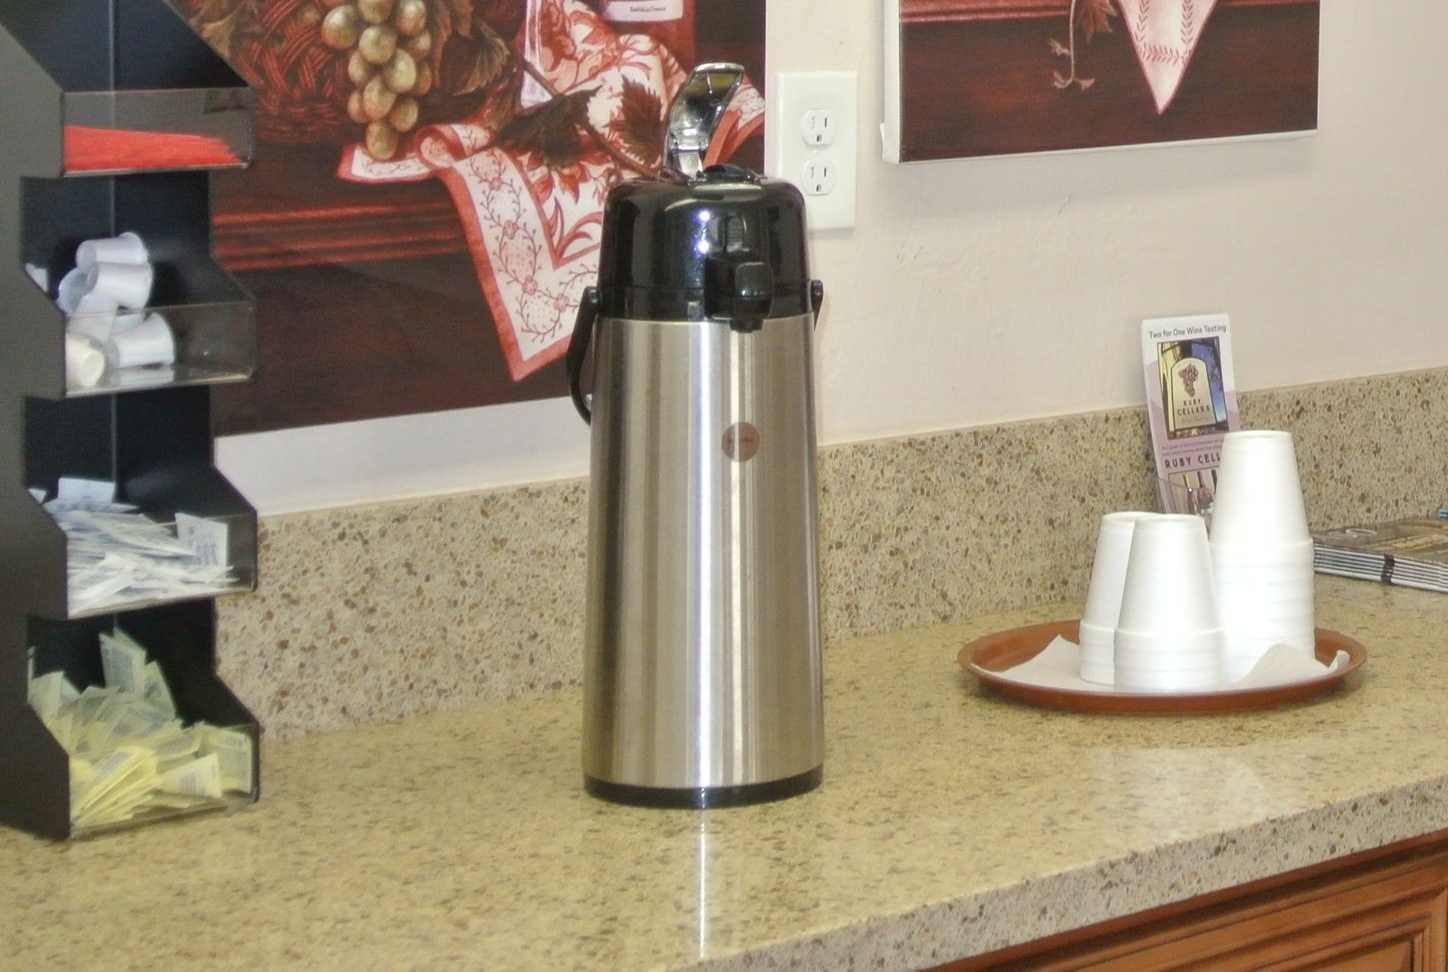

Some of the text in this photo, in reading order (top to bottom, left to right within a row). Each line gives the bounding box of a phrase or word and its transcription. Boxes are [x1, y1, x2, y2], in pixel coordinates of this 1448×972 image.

[1149, 323, 1227, 339] Two for One Wine Tasting
[1183, 398, 1201, 406] RUBY
[1177, 405, 1210, 416] CELLARS
[1165, 456, 1191, 468] RUBY
